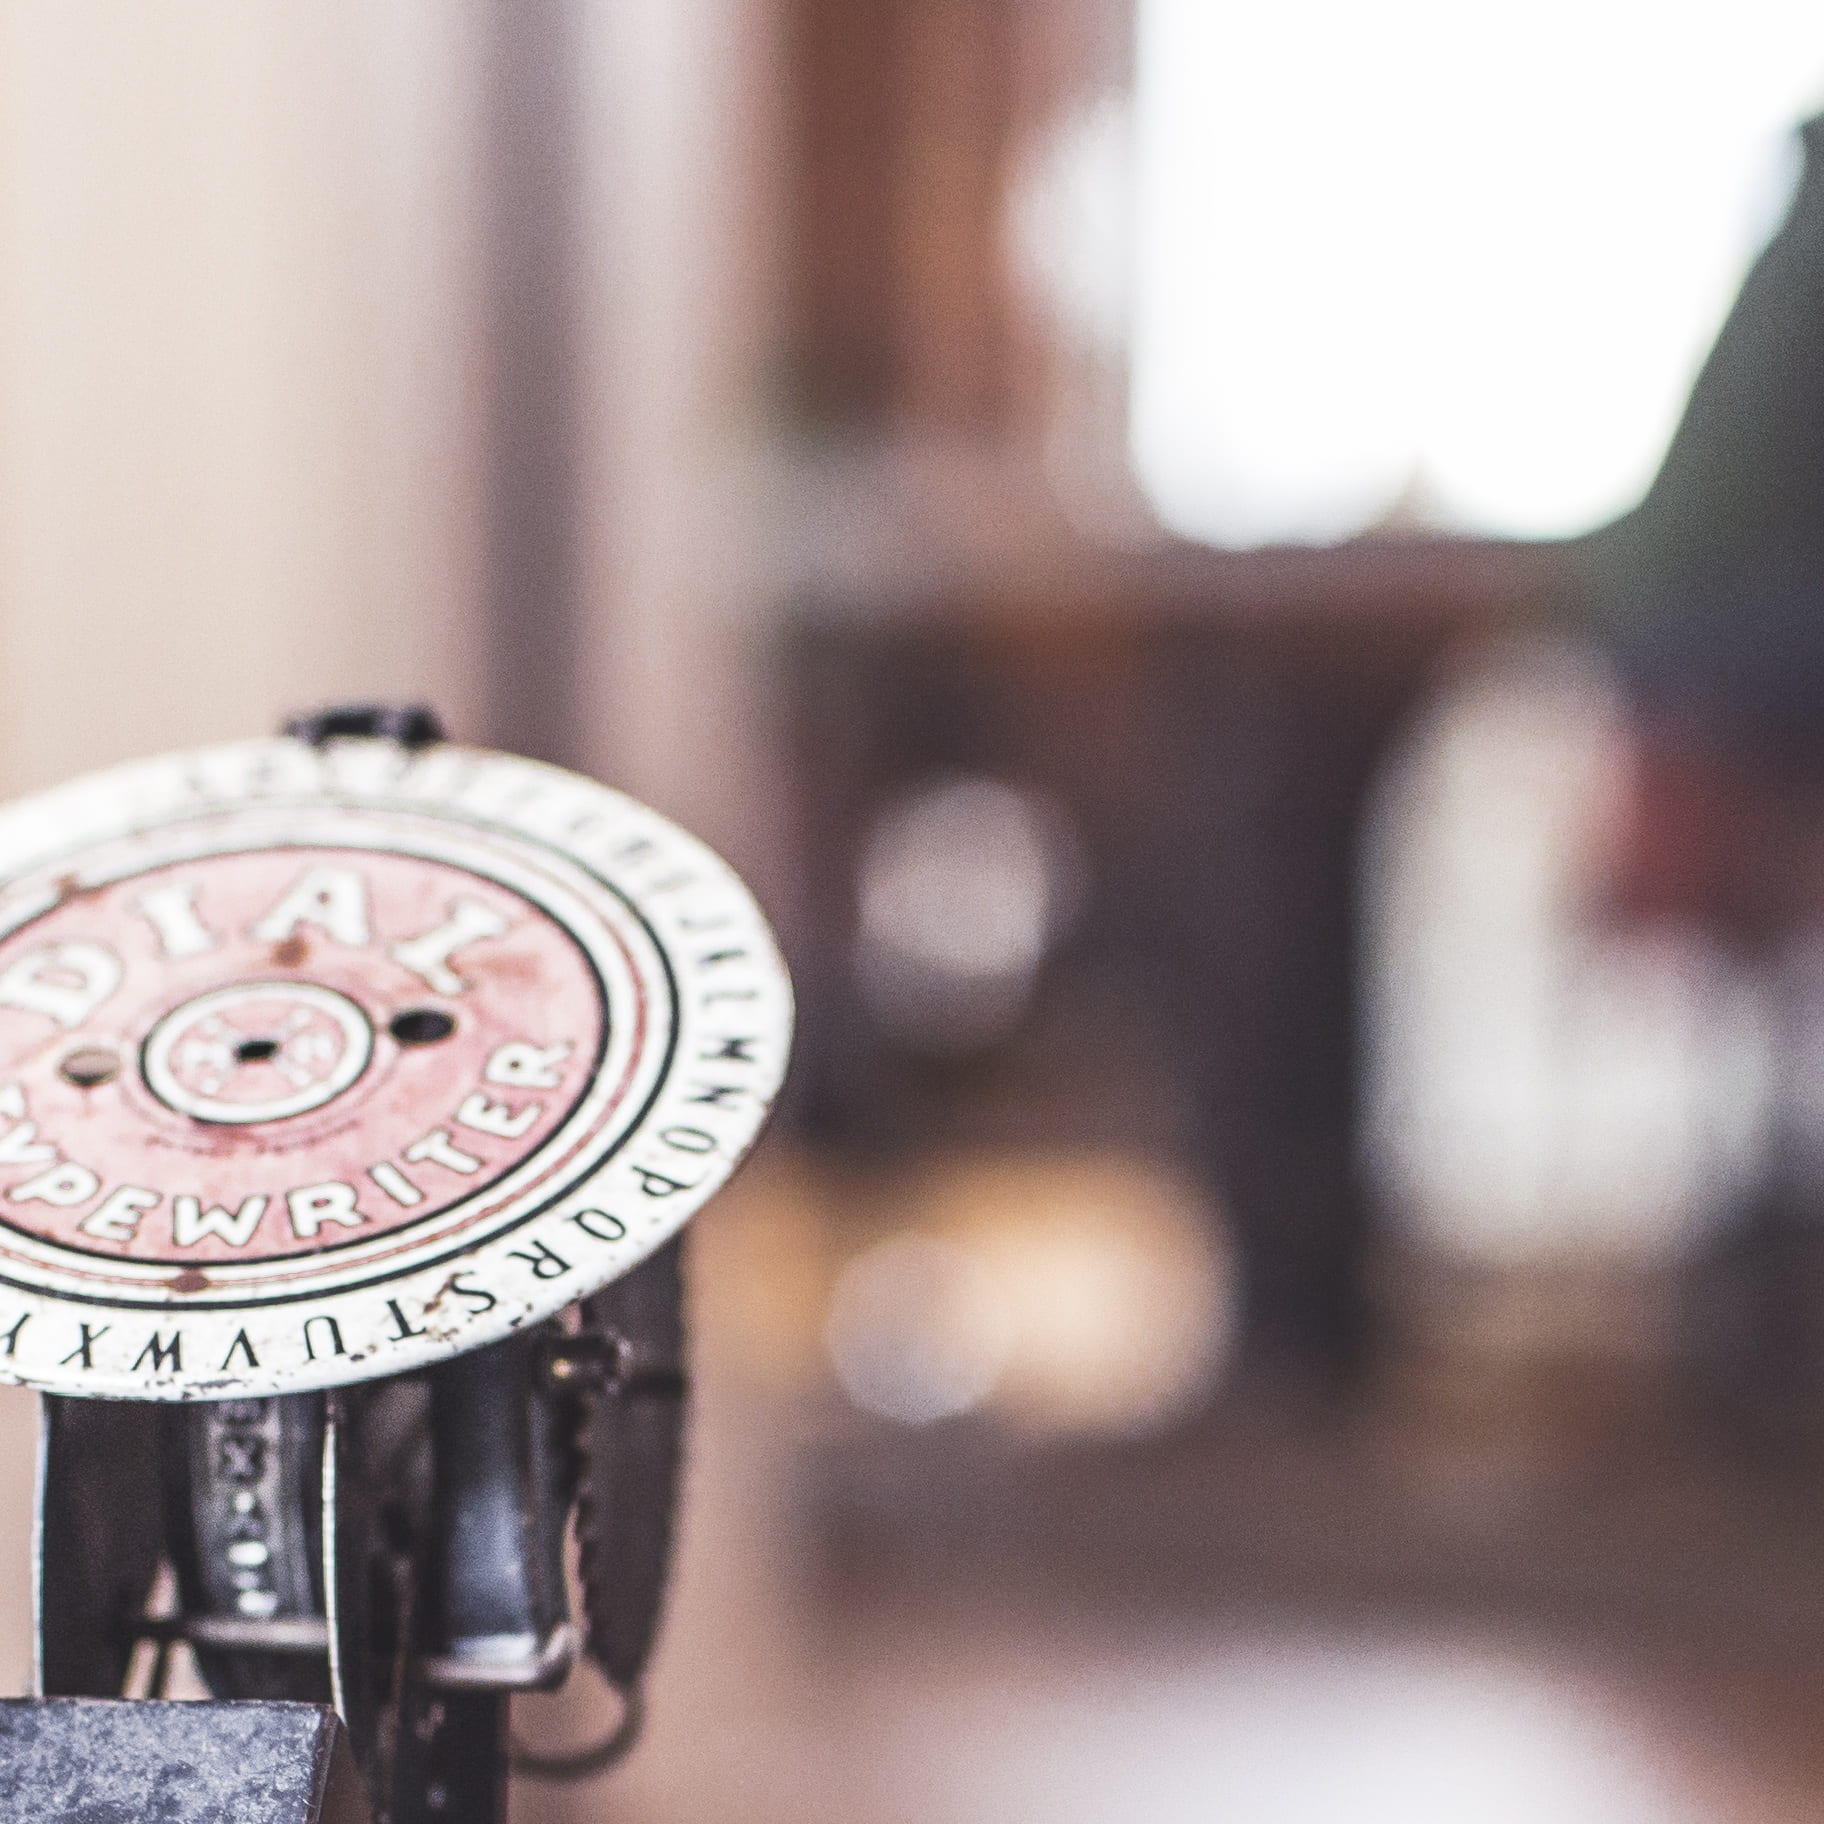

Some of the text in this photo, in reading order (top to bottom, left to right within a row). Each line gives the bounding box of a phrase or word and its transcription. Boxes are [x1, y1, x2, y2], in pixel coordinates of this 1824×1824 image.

[630, 1162, 696, 1199] P
[570, 1206, 629, 1243] Q
[506, 1238, 574, 1283] R
[451, 1270, 499, 1316] S
[302, 1314, 348, 1362] U
[384, 1296, 428, 1344] T
[58, 1321, 111, 1370] X
[130, 1330, 183, 1373] W
[219, 1327, 260, 1371] V
